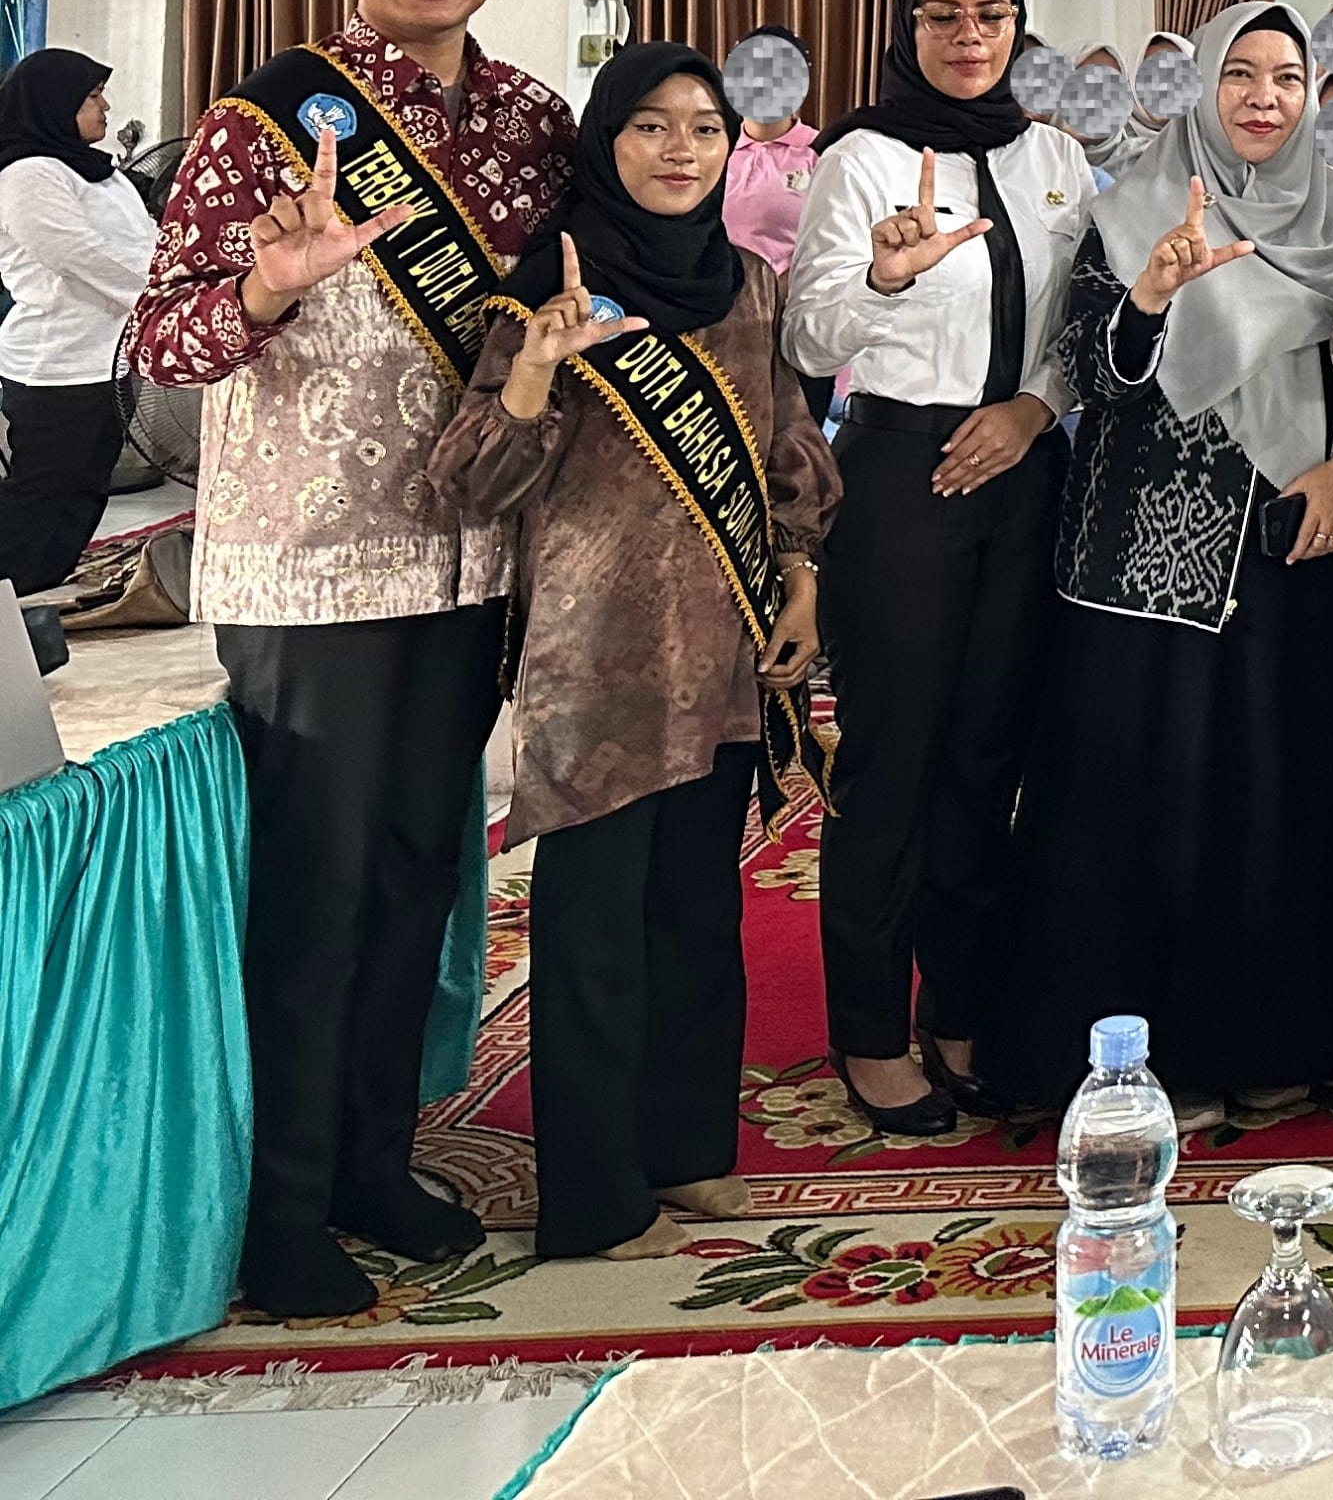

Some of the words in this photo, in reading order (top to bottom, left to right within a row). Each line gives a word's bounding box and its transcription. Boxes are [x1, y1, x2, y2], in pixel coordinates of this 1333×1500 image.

[408, 241, 479, 311] DUTA
[615, 334, 688, 411] DUTA
[663, 390, 739, 500] BAHASA
[1081, 1332, 1161, 1362] Minerale
[1109, 1325, 1133, 1345] Le
